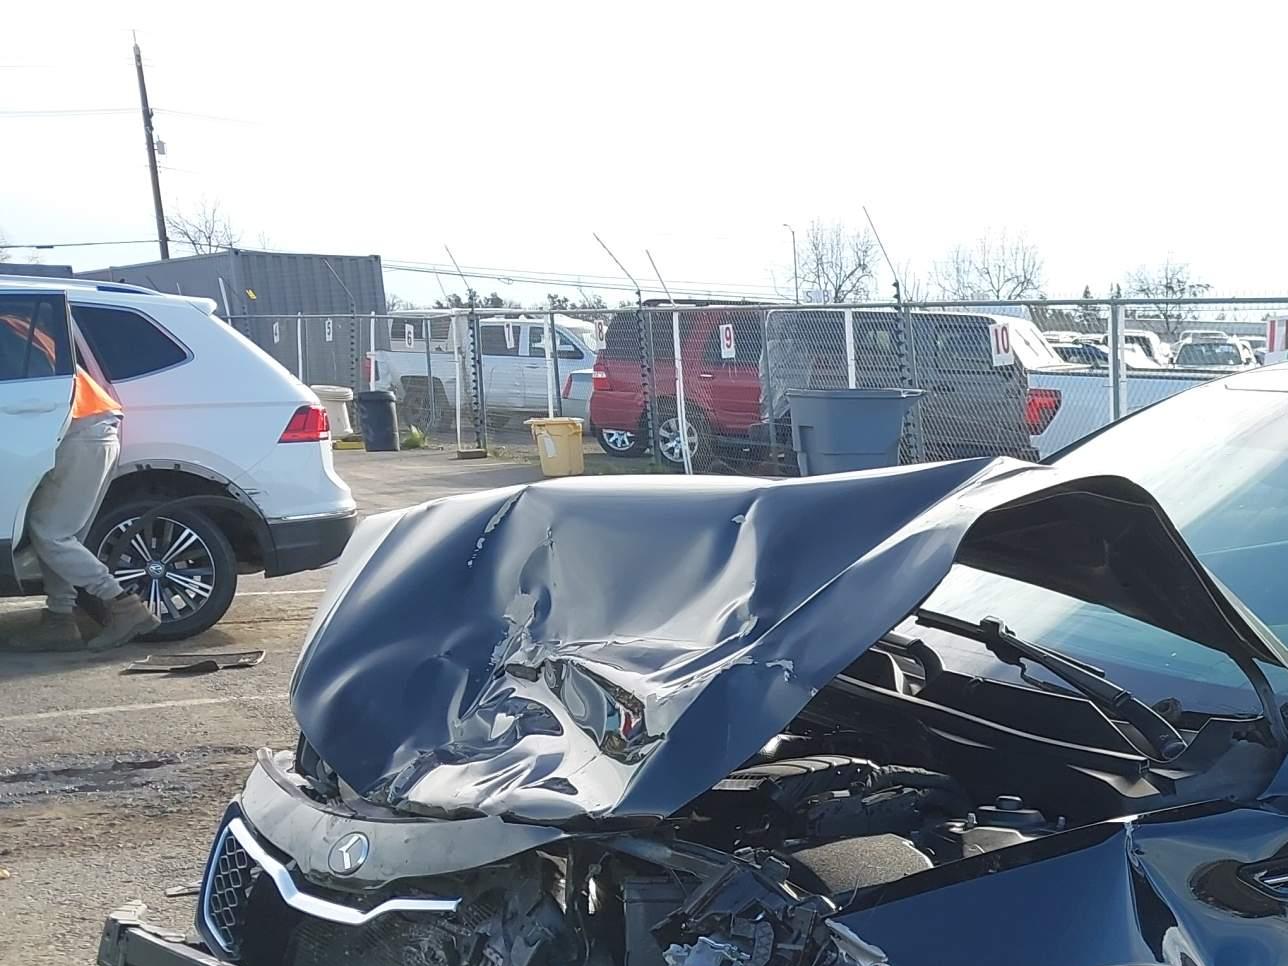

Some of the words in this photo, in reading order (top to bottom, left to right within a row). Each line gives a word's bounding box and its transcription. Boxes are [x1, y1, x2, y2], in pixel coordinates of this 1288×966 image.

[406, 330, 412, 346] 6
[598, 321, 604, 341] 8
[725, 326, 732, 348] 9
[994, 325, 1010, 354] 10
